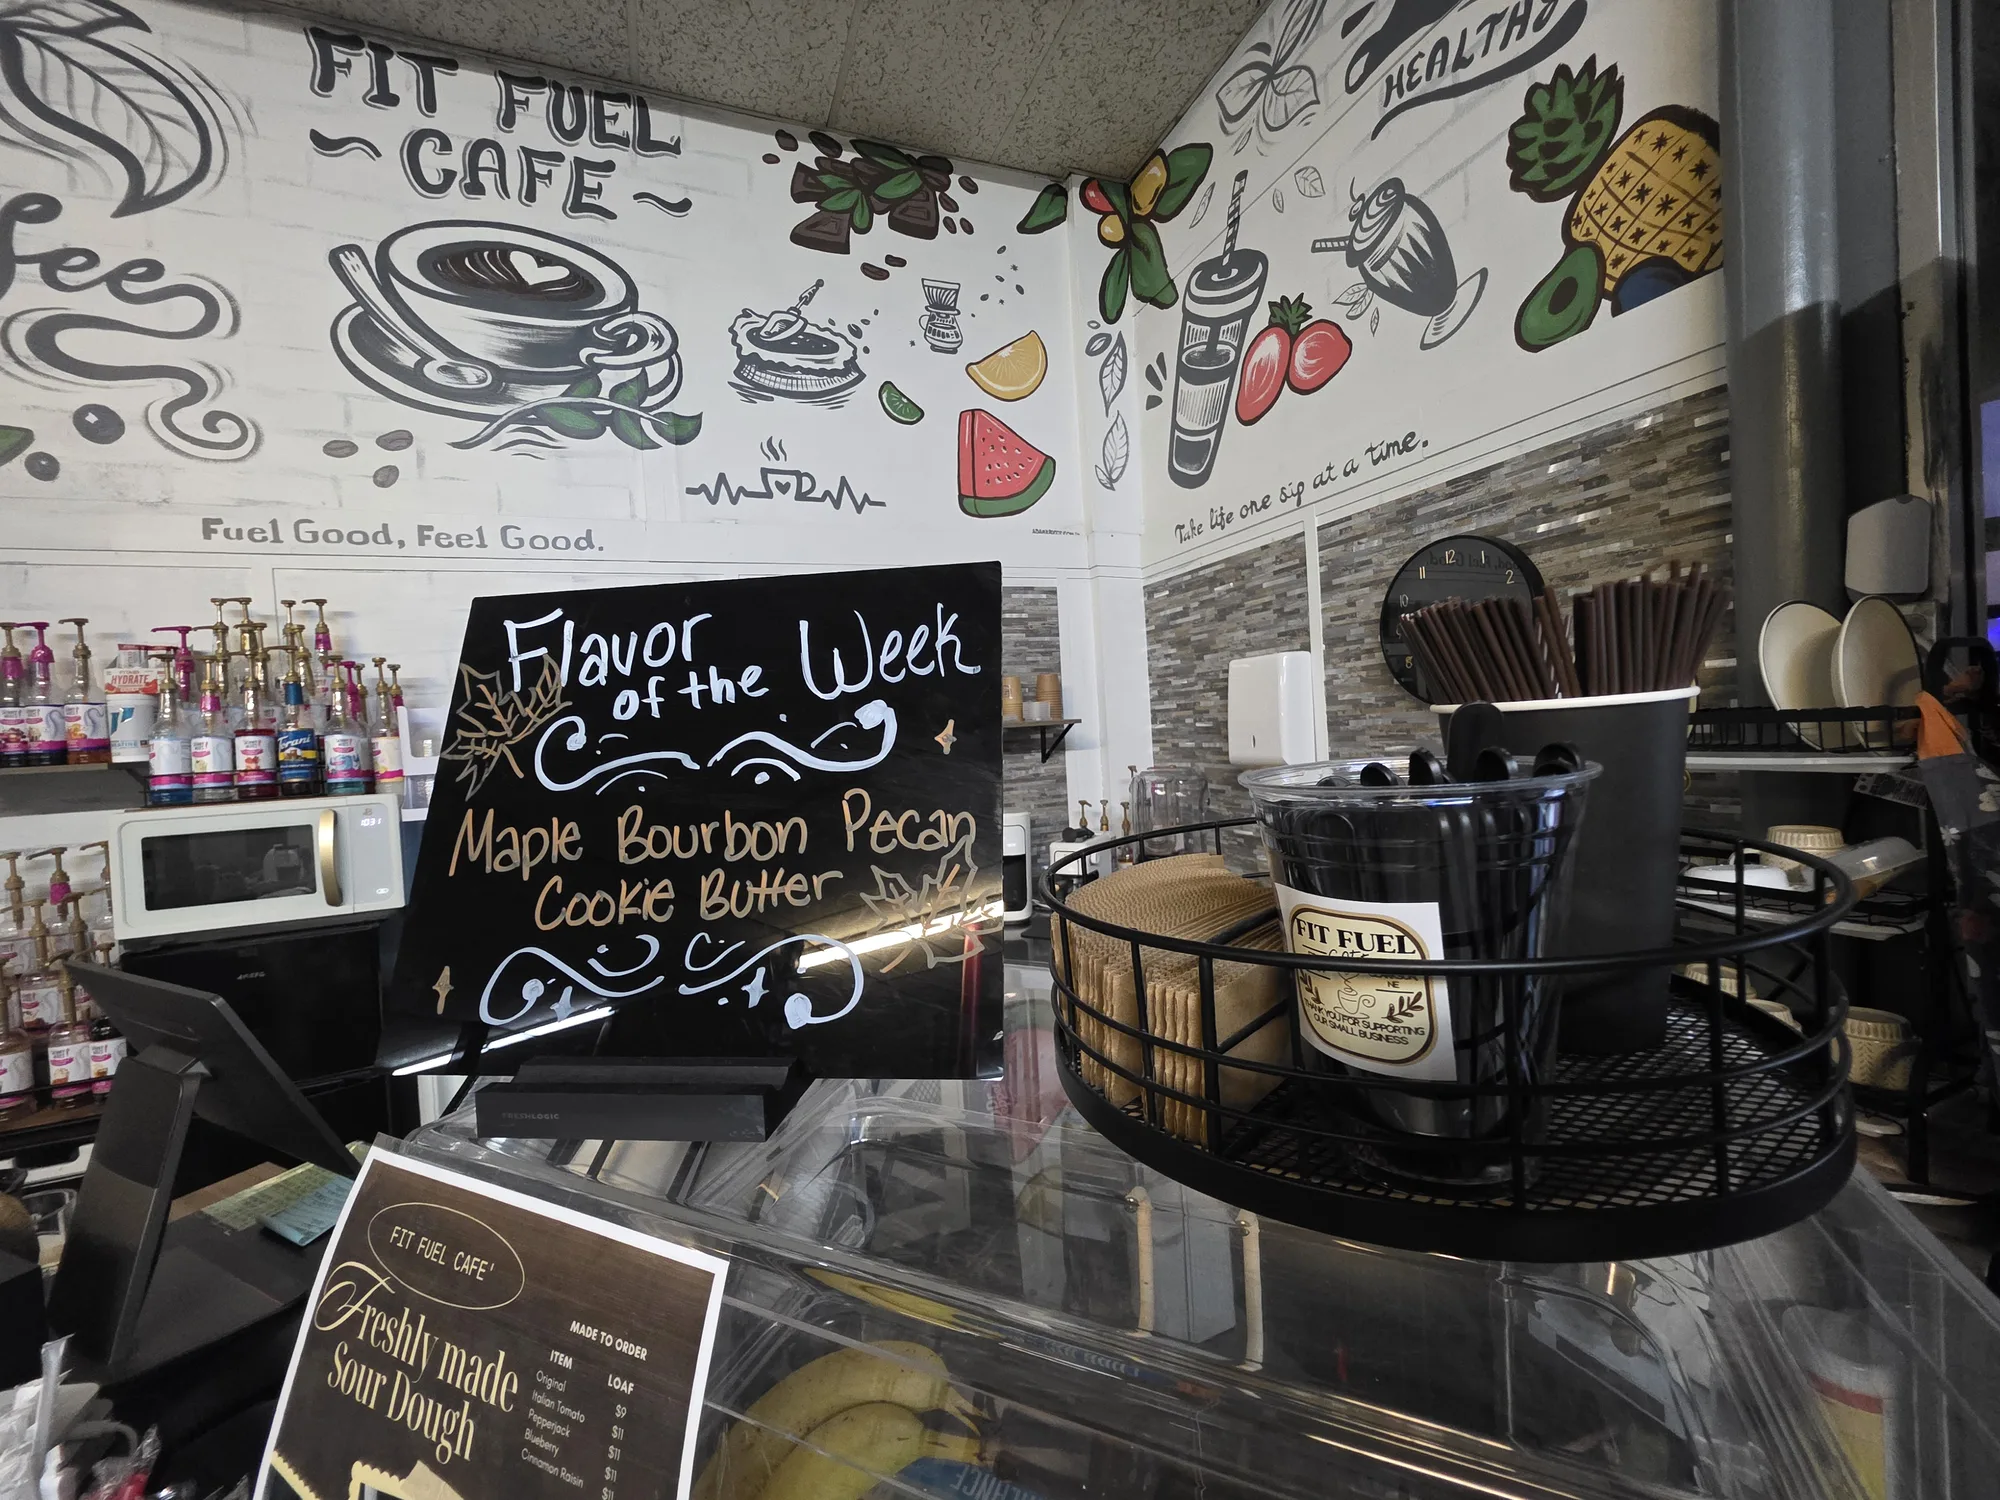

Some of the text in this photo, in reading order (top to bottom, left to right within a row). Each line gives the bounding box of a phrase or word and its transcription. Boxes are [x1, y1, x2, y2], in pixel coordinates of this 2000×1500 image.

[304, 27, 681, 154] FIT FUEL
[400, 128, 618, 220] CAFE
[1174, 431, 1429, 544] Take life one sip at a time.
[201, 517, 604, 552] Fuel Good, Feel Good.
[1445, 549, 1456, 564] 12
[1419, 566, 1425, 579] 11
[1505, 569, 1515, 585] 2
[1400, 594, 1409, 609] 10
[111, 675, 150, 685] HYDRATE
[502, 602, 981, 721] Flavor of the Week
[448, 787, 977, 881] Maple Bourbon Pecan
[534, 867, 843, 931] Cookie Butter
[1295, 917, 1416, 954] FIT FUEL
[1304, 998, 1426, 1036] THANK YOU FOR SUPPORTING
[1314, 1014, 1410, 1045] OUR SMALL BUSINESS
[389, 1226, 415, 1249] FIT
[417, 1237, 447, 1266] FUEL
[314, 1260, 519, 1413] Freshly made
[570, 1320, 648, 1361] MADE TO ORDER
[536, 1370, 627, 1419] Original $9
[549, 1349, 634, 1395] ITEM LOAF
[327, 1340, 476, 1465] Sour Dough
[532, 1389, 624, 1440] Italian Tomato $11
[524, 1428, 617, 1482] Blueberry $11
[528, 1408, 621, 1461] Pepperjack $11
[521, 1447, 614, 1500] Cinnamon Raisin $11
